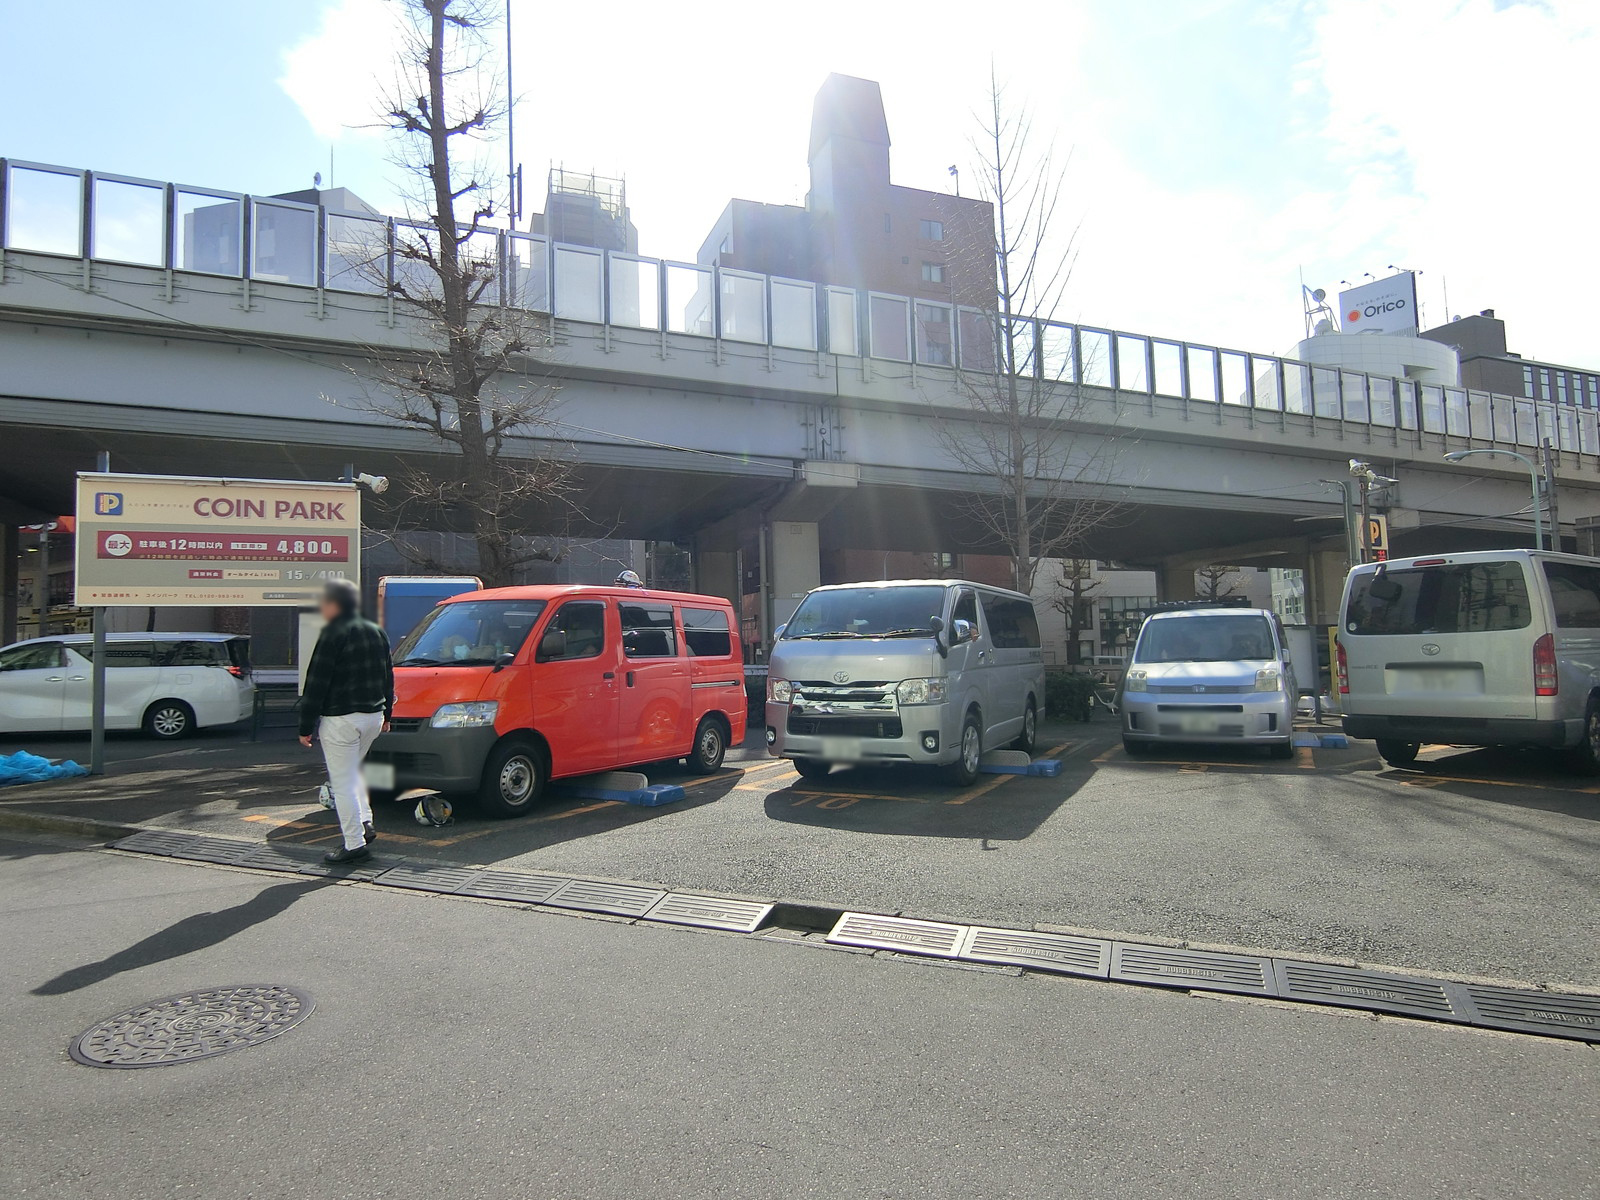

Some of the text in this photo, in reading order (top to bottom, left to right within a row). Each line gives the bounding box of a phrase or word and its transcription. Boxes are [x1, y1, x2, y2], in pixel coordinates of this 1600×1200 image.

[1364, 299, 1405, 317] Orico
[193, 497, 346, 520] COIN PARK
[108, 540, 130, 550] 最大
